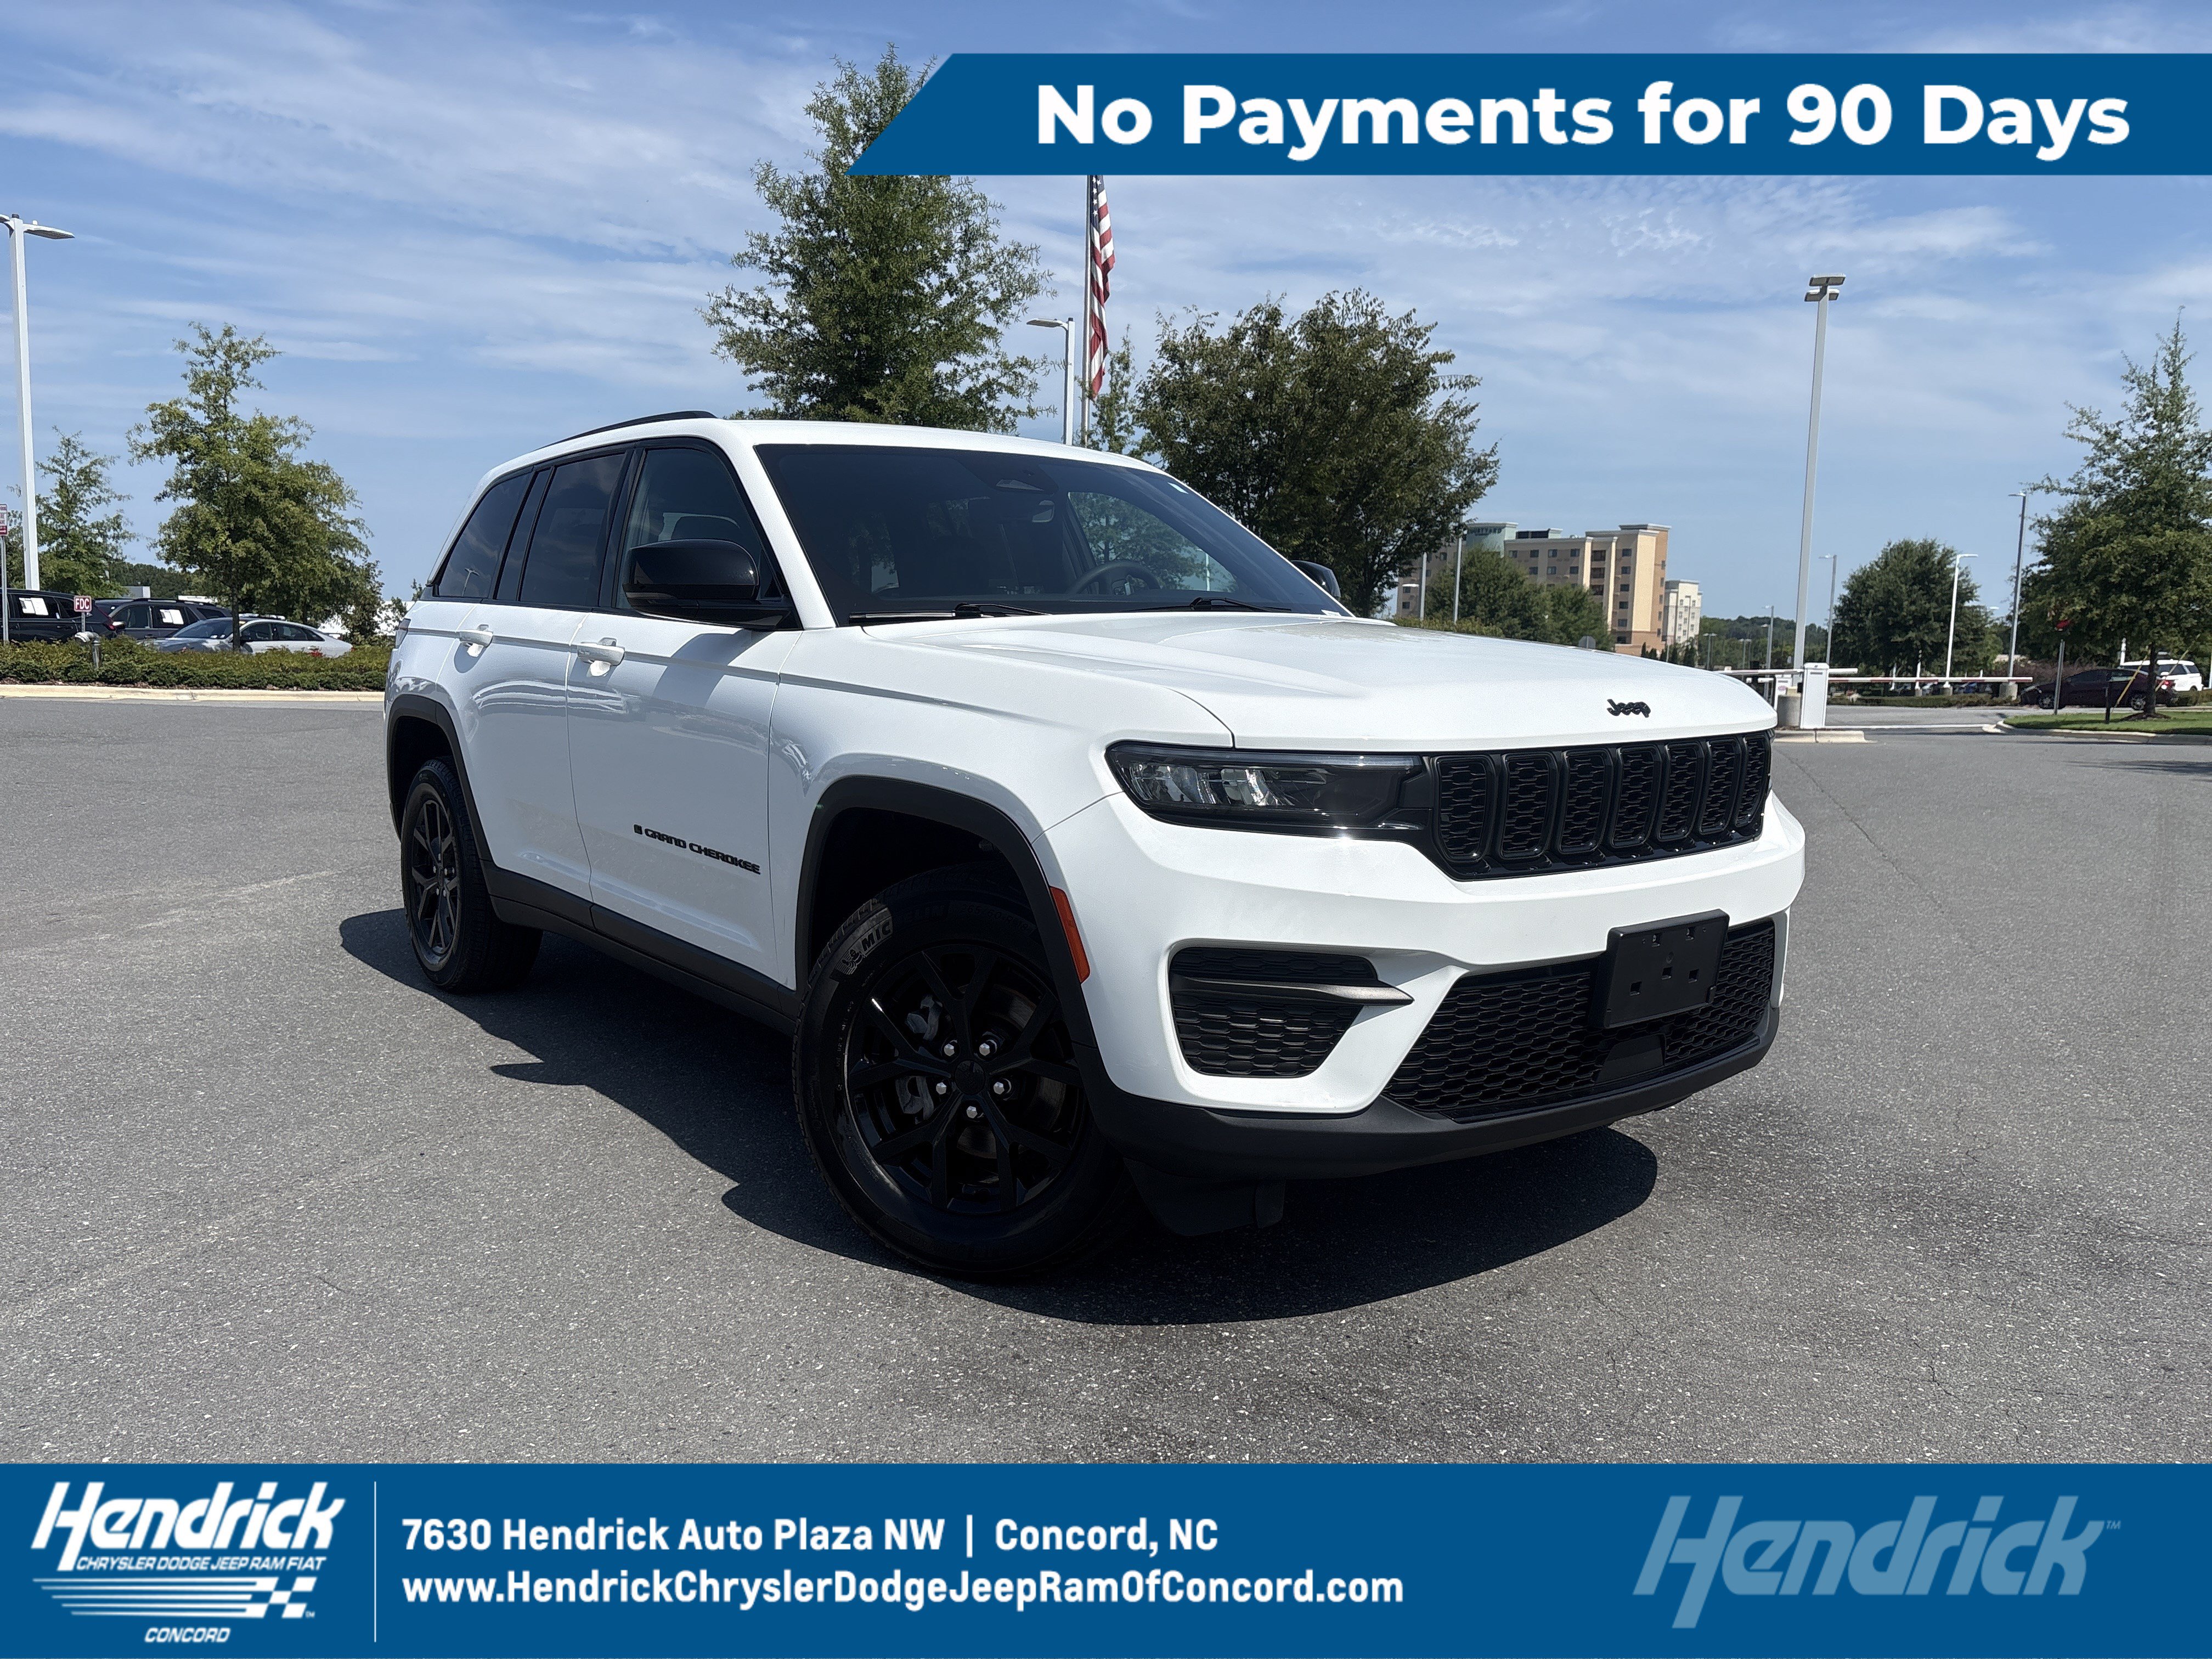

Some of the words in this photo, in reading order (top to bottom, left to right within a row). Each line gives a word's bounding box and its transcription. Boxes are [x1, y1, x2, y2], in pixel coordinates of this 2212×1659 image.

[75, 598, 89, 609] FDC
[1607, 699, 1651, 718] Jeep
[645, 828, 686, 848] GRAND
[689, 843, 761, 874] CHEROKEE
